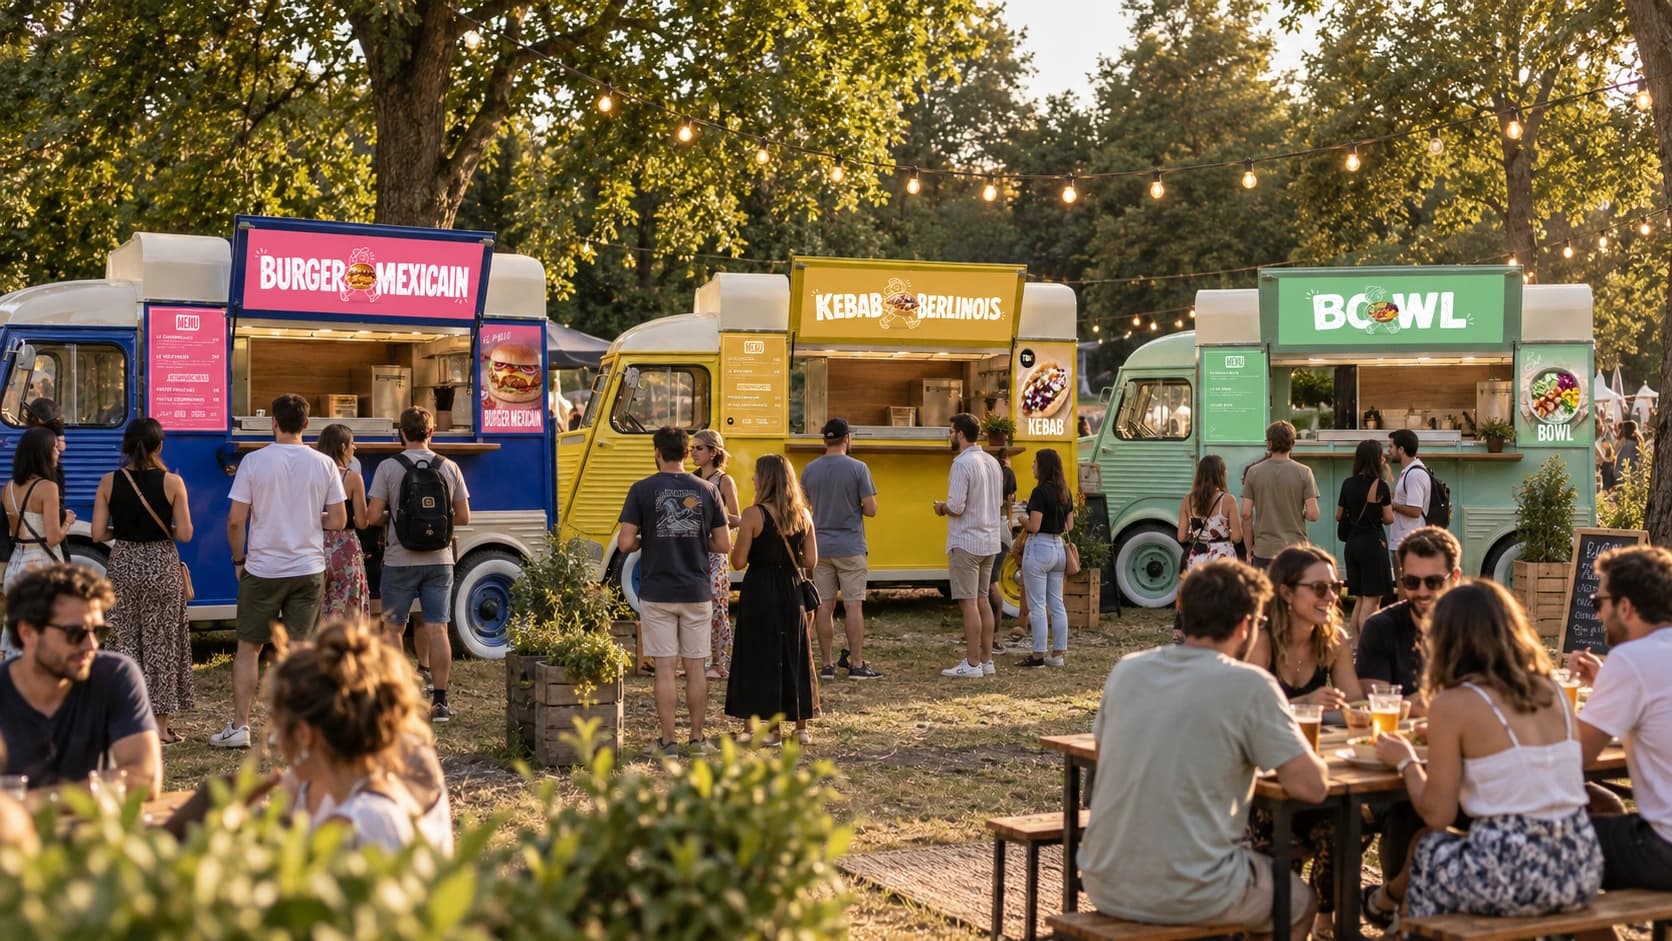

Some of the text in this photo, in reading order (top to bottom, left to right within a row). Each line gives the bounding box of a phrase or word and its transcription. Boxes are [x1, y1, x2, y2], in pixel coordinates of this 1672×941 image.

[259, 255, 470, 298] BURGER MEXICAIN
[815, 292, 1002, 321] KEBAB BERLINOIS
[1312, 291, 1467, 331] BOWL
[177, 316, 199, 330] MENU
[484, 409, 510, 427] BURGER
[1028, 417, 1064, 436] KEBAB
[1537, 424, 1574, 442] BOWL
